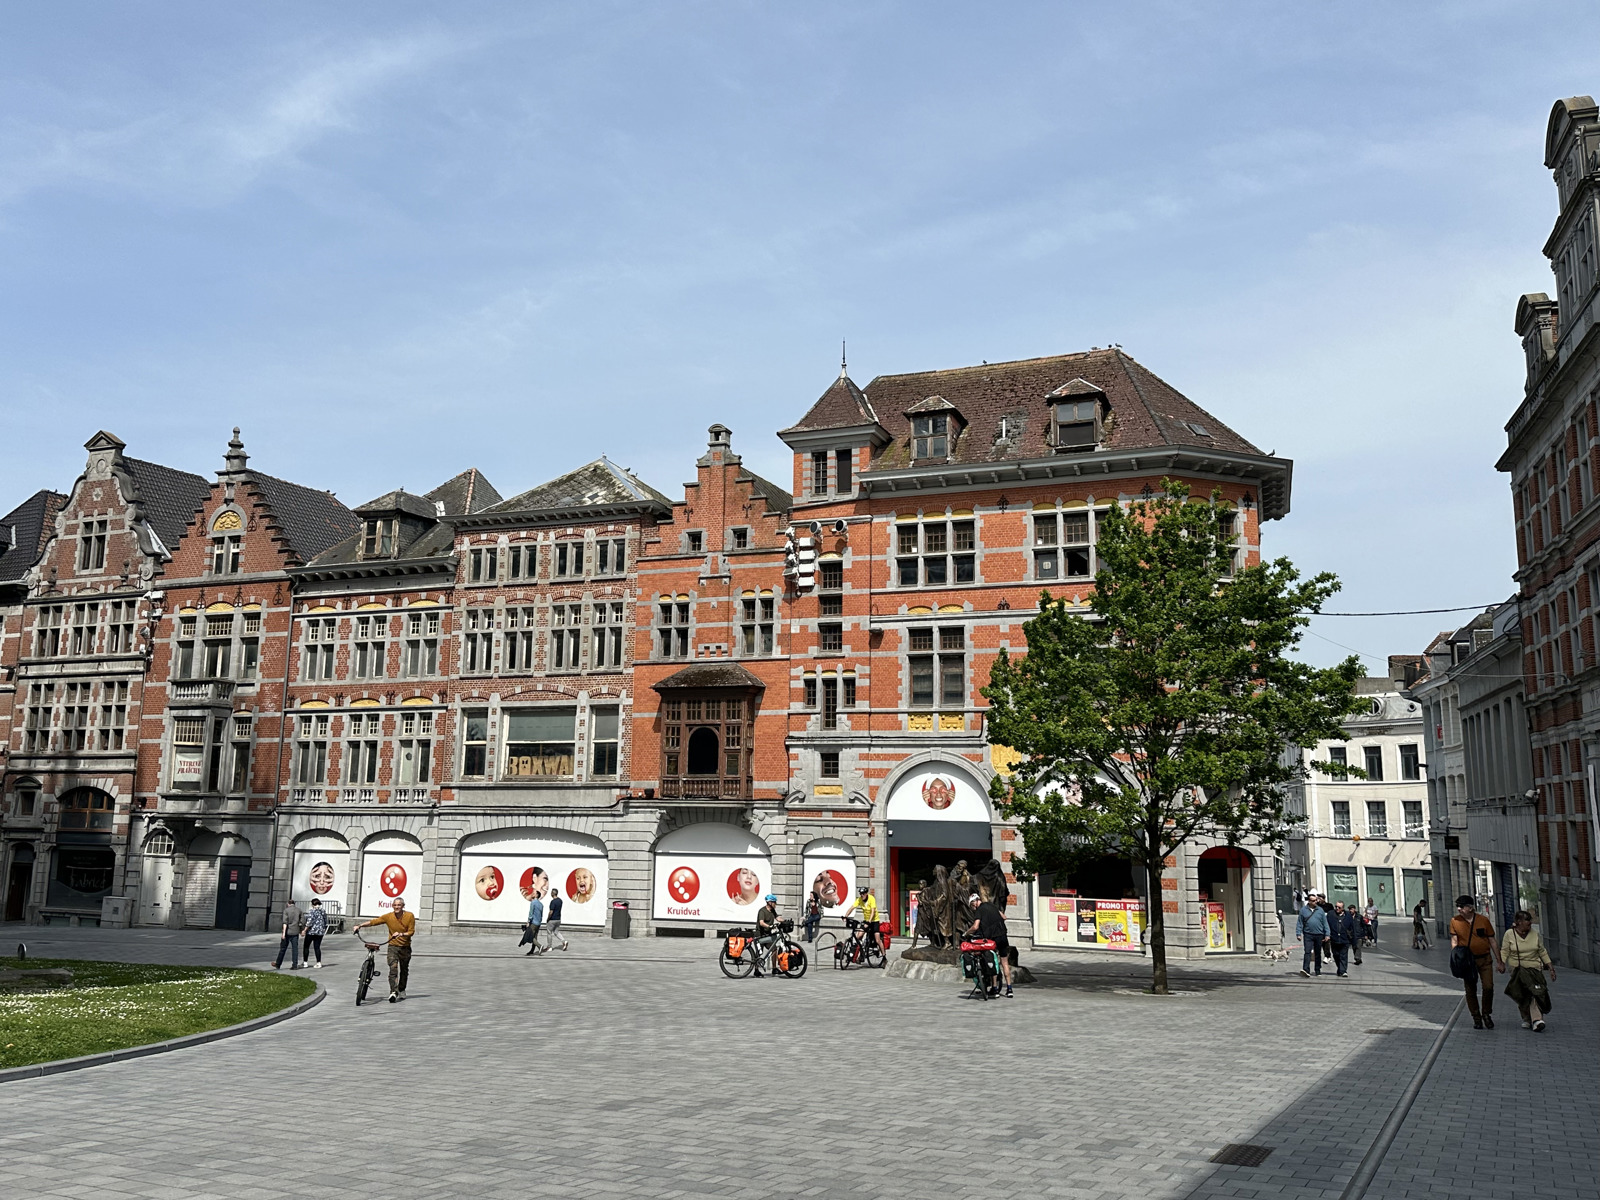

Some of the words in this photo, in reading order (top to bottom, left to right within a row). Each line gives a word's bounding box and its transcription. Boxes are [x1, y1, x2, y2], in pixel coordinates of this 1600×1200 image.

[378, 900, 393, 908] Krui
[1097, 902, 1124, 910] PROMO!
[667, 906, 700, 916] Kruidvat
